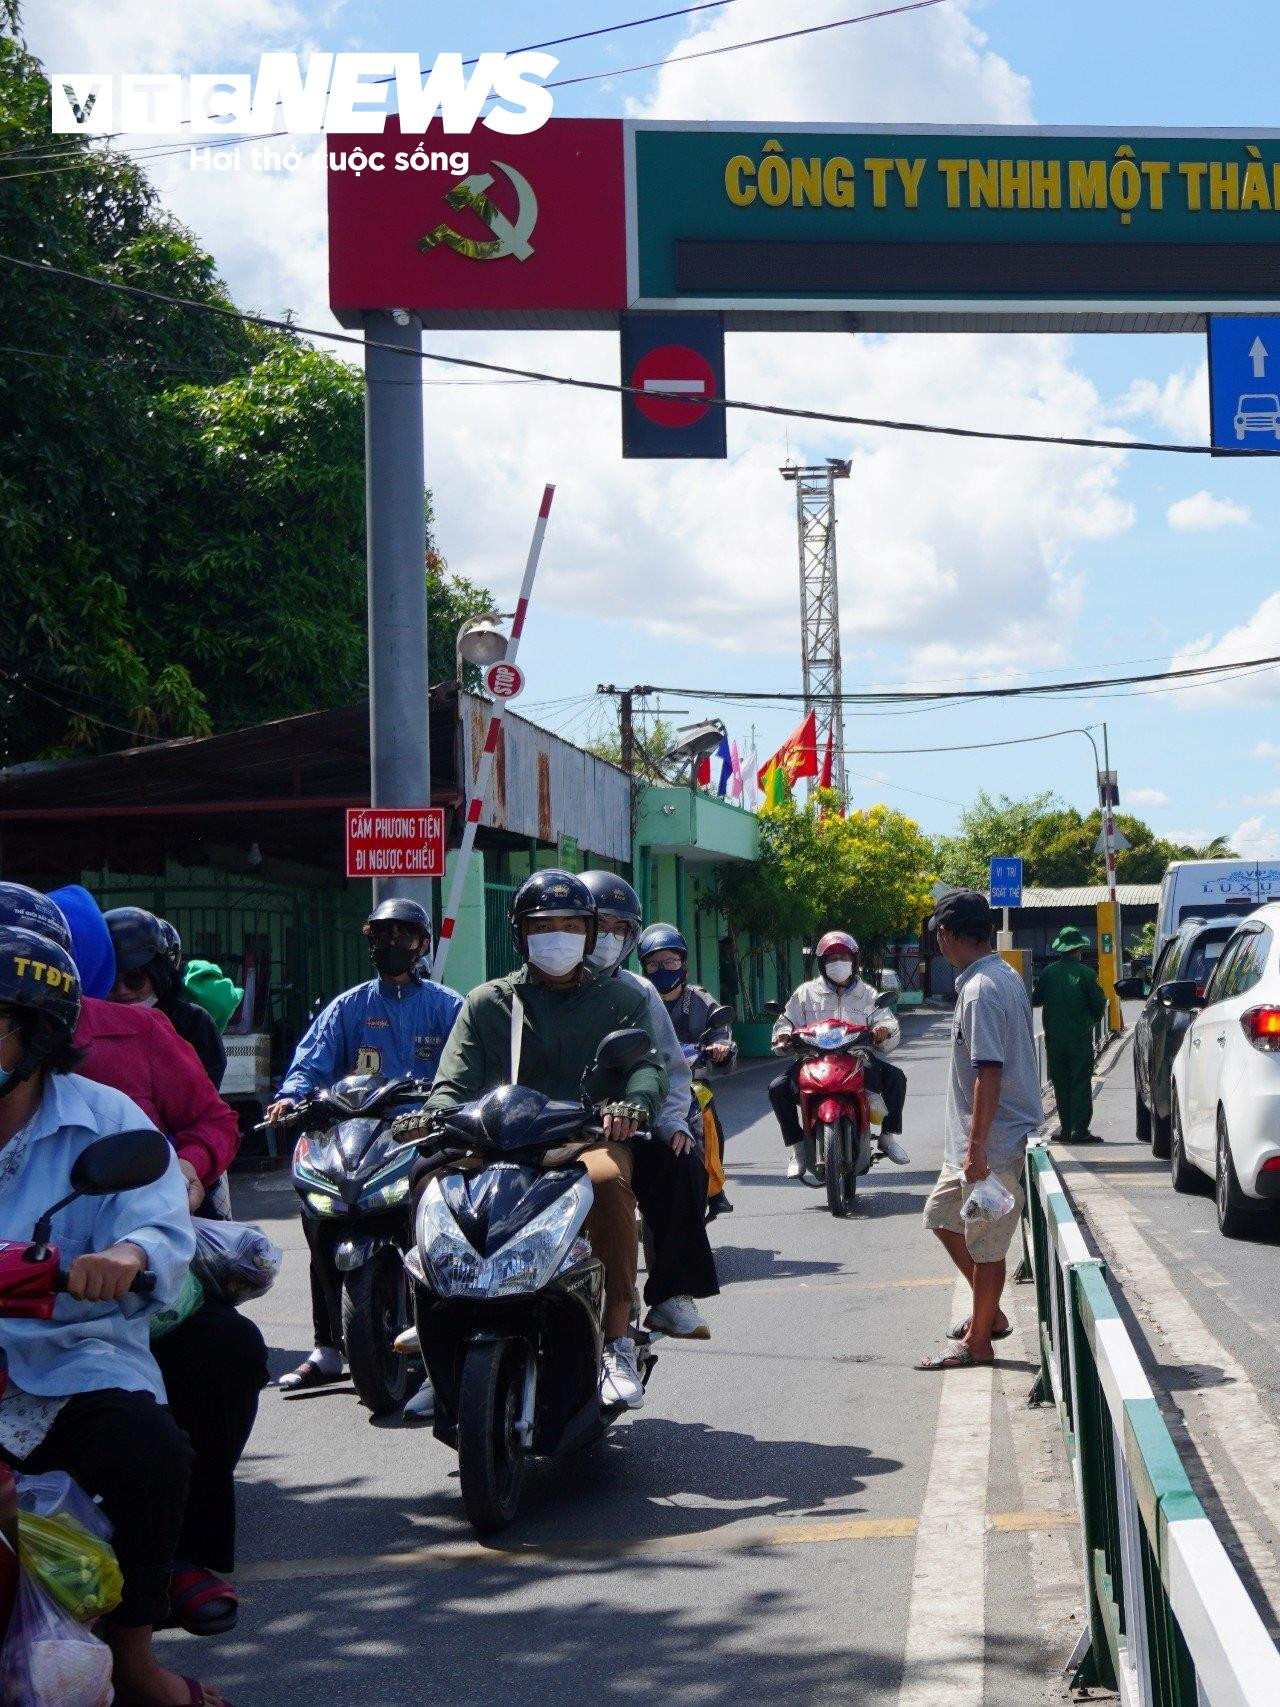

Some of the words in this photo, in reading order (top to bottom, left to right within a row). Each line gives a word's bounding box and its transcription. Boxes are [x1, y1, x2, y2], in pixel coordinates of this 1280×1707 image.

[725, 139, 855, 209] CÔNG
[864, 158, 926, 209] TY
[937, 158, 1062, 210] TNHH
[1068, 144, 1171, 226] MỘT
[493, 666, 516, 696] STOP
[351, 811, 372, 839] CẤM
[375, 816, 416, 839] PHƯƠNG
[418, 813, 441, 842] TIỆN
[355, 848, 367, 871] ĐI
[368, 847, 403, 874] NGƯỢC
[405, 841, 435, 870] CHIỀU
[1245, 869, 1267, 877] VIP
[13, 956, 74, 993] TTĐT
